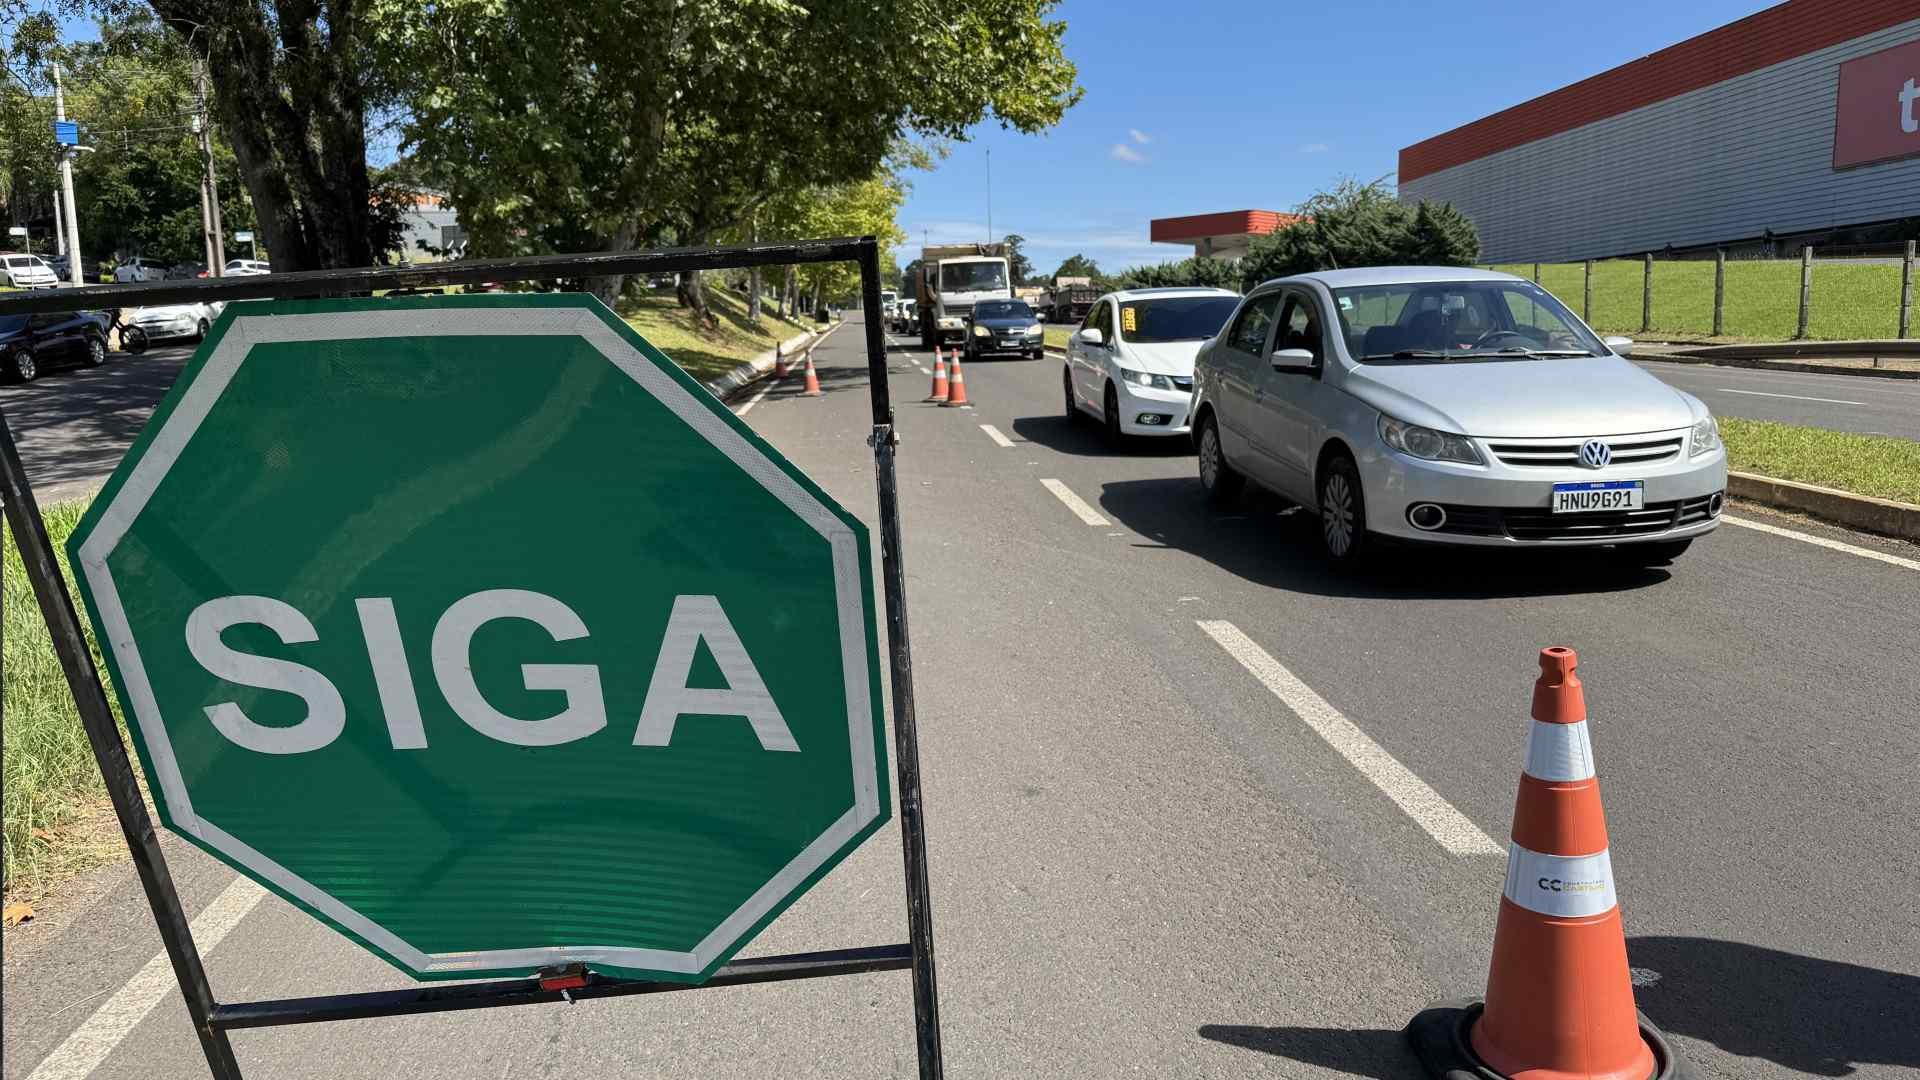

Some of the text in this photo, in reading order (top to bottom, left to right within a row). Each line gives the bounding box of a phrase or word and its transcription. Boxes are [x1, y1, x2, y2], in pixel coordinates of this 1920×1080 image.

[1560, 491, 1633, 510] HNU9G91
[185, 588, 801, 754] SIGA
[1538, 877, 1561, 892] CC
